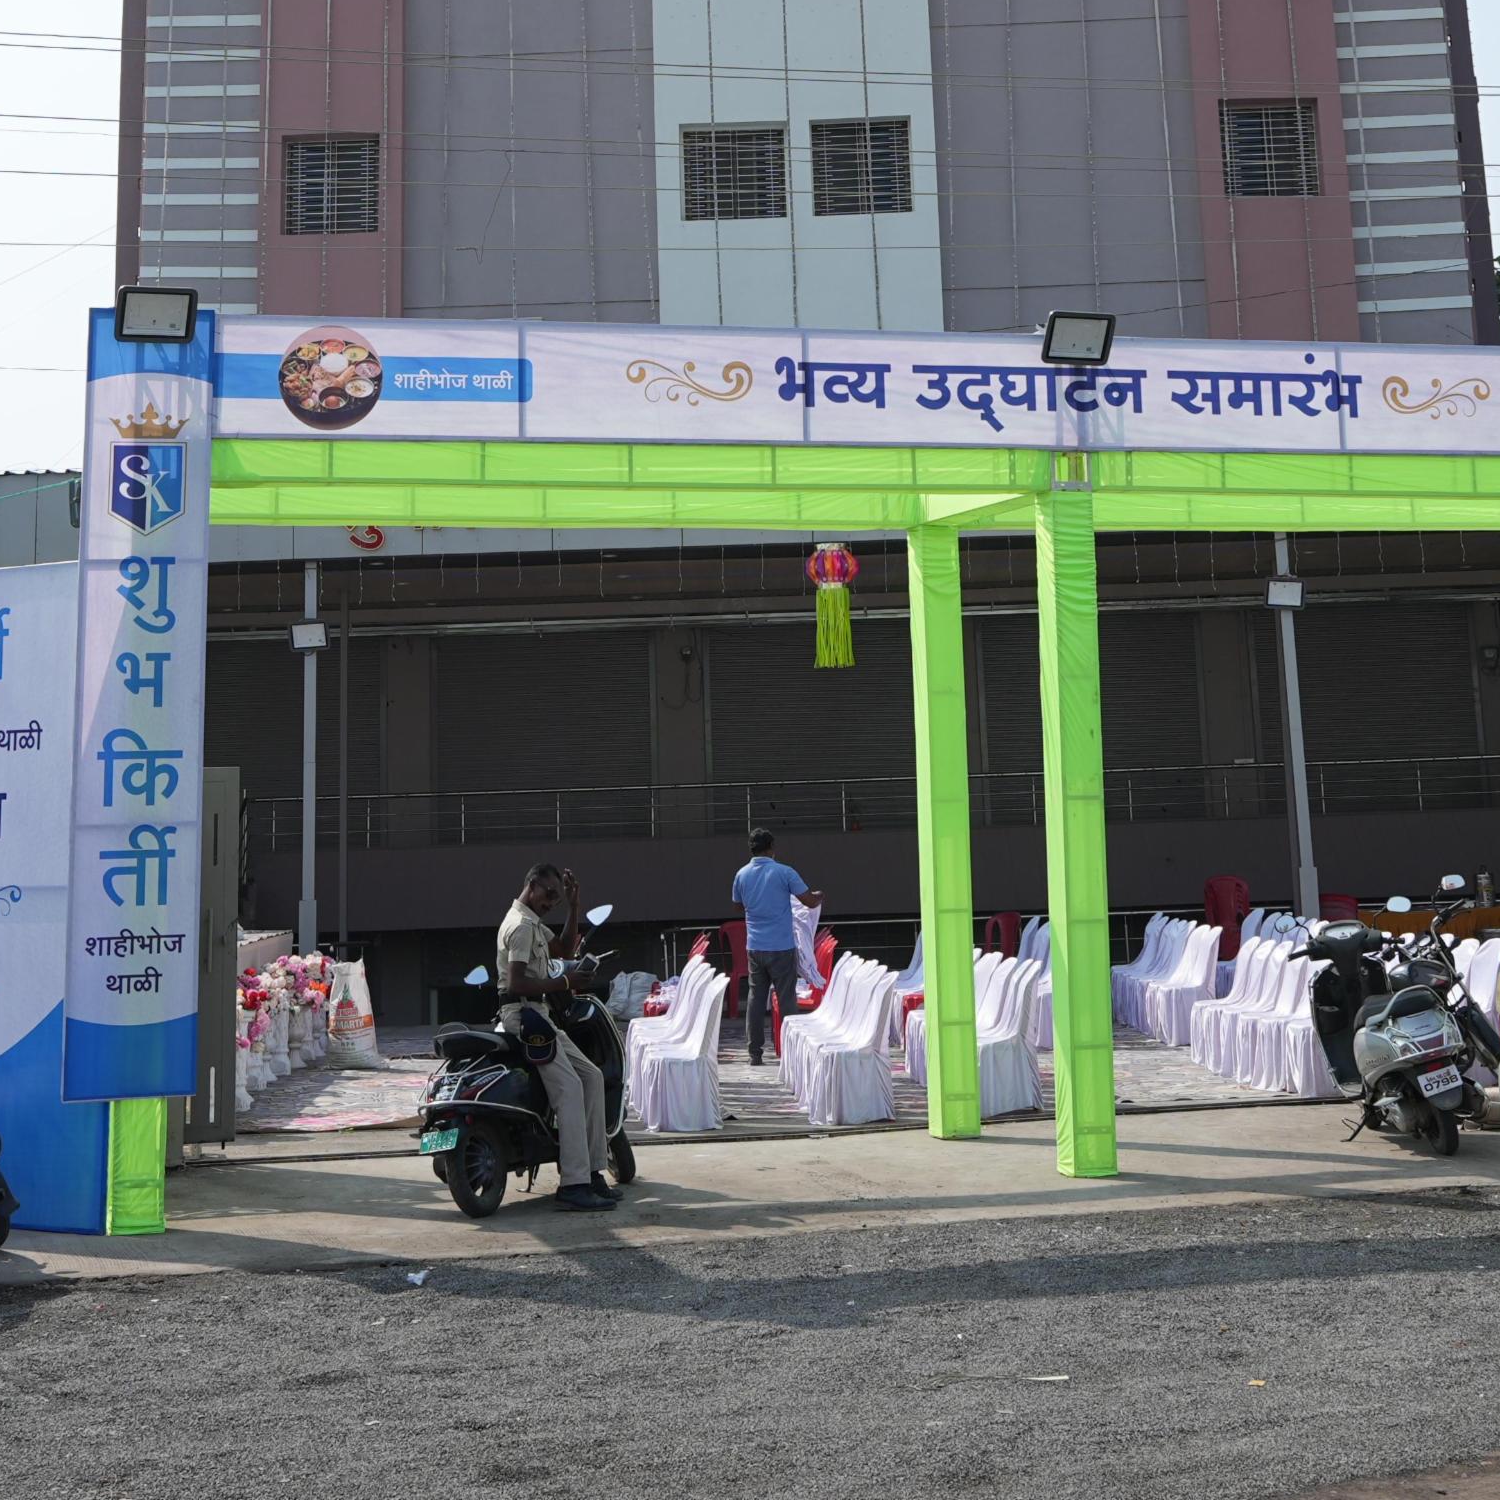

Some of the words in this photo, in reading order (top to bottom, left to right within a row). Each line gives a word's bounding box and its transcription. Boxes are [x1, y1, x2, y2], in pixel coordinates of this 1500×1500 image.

[393, 368, 468, 391] शाहीभोज
[472, 370, 514, 390] थाळी
[775, 356, 891, 409] भव्य
[912, 364, 1147, 432] उद्घाटन
[1167, 353, 1362, 419] समारंभ
[84, 926, 186, 957] शाहीभोज
[105, 968, 163, 995] थाळी
